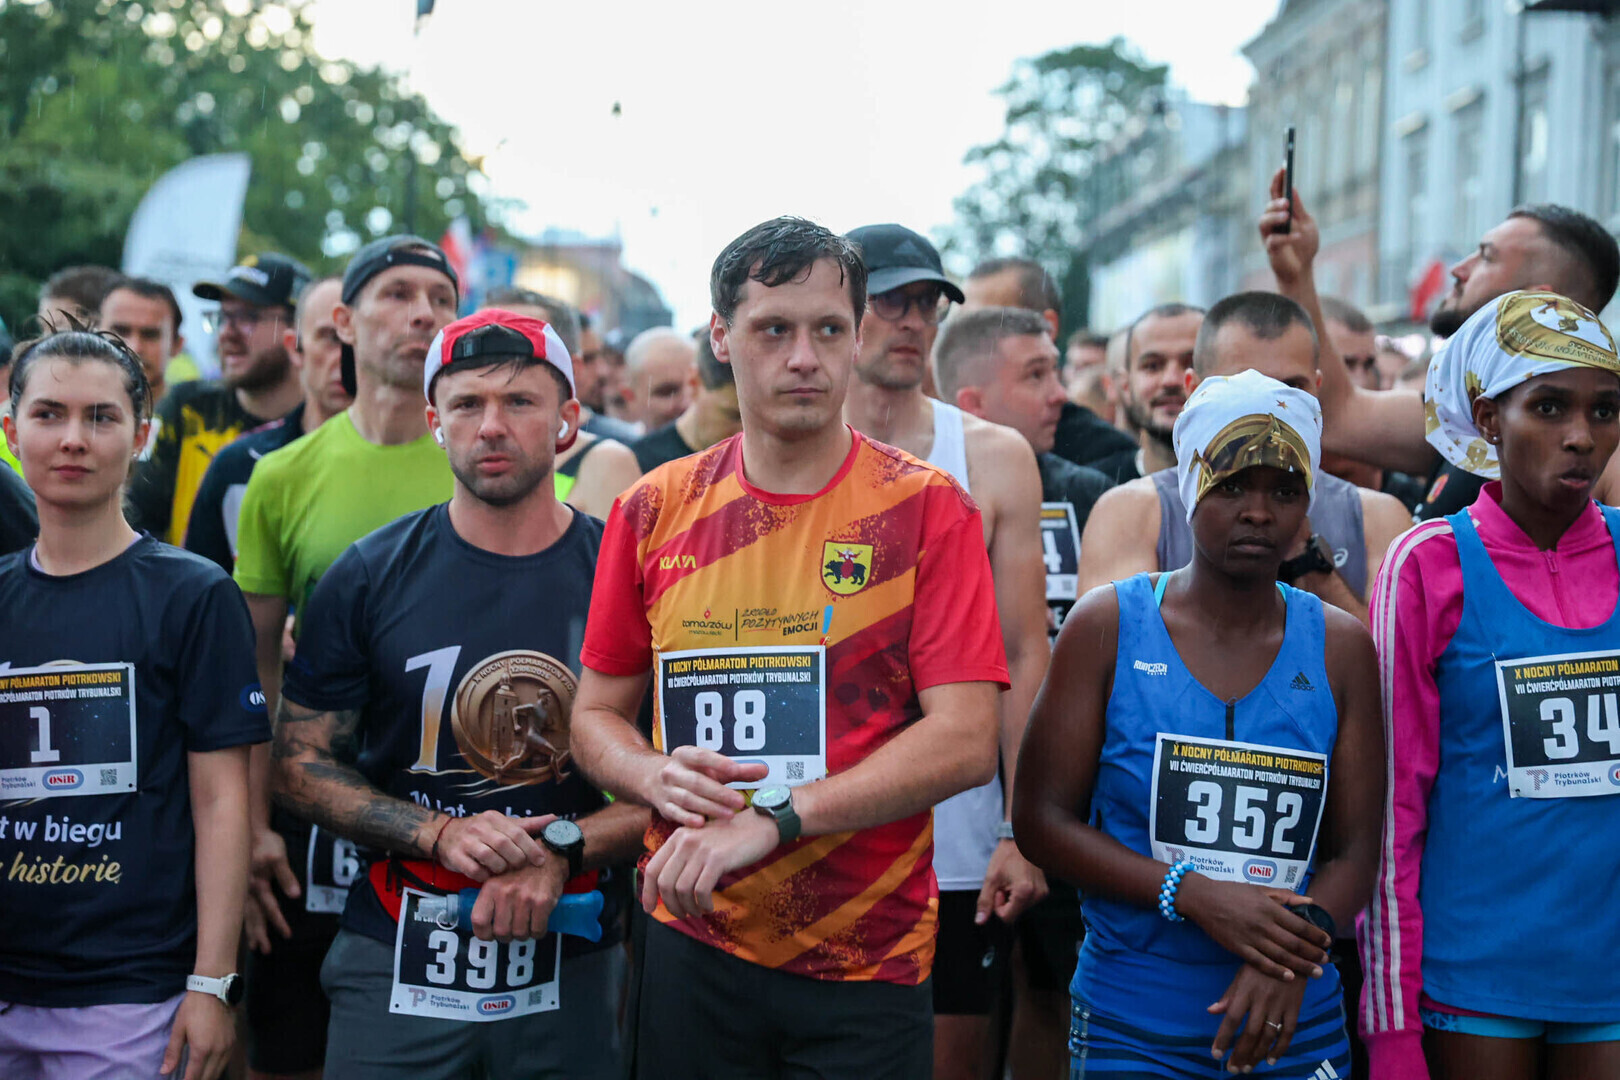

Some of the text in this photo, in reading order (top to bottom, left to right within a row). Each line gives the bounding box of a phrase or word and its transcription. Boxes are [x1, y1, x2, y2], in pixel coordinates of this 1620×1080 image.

[782, 622, 818, 636] EMOCJI
[673, 660, 692, 673] NOCNY
[693, 656, 747, 671] PÓŁMARATON
[749, 655, 811, 669] PIOTRKOWSKI
[1515, 659, 1618, 679] X NOCNY PÓŁMARATON
[62, 672, 121, 685] PIOTRKOWSKI
[729, 670, 764, 684] PIOTRKÓW
[765, 671, 811, 683] TRYBUNALSKI
[1515, 684, 1526, 695] VII
[1526, 677, 1601, 694] ĆWIERĆPÓŁMARATON
[44, 687, 77, 700] PIOTRKÓW
[78, 686, 122, 698] TRYBUNALSKI
[695, 689, 766, 752] 88
[1539, 693, 1620, 760] 34
[29, 706, 60, 763] 1
[1173, 744, 1179, 756] X
[1181, 745, 1213, 760] NOCNY
[1214, 747, 1273, 768] PÓŁMARATON
[1169, 759, 1179, 771] VII
[1180, 758, 1254, 780] ĆWIERĆPÓŁMARATON
[1254, 768, 1288, 785] PIOTRKÓW
[1554, 771, 1590, 779] Piotrków
[1555, 777, 1602, 787] Trybunalski
[1184, 780, 1303, 854] 352
[15, 821, 38, 840] w
[44, 815, 122, 847] biegu
[1190, 855, 1224, 866] Piotrków
[1249, 866, 1272, 877] OSiR
[426, 929, 537, 990] 398
[430, 1000, 470, 1011] Trybunalski
[431, 994, 461, 1003] Piotrków
